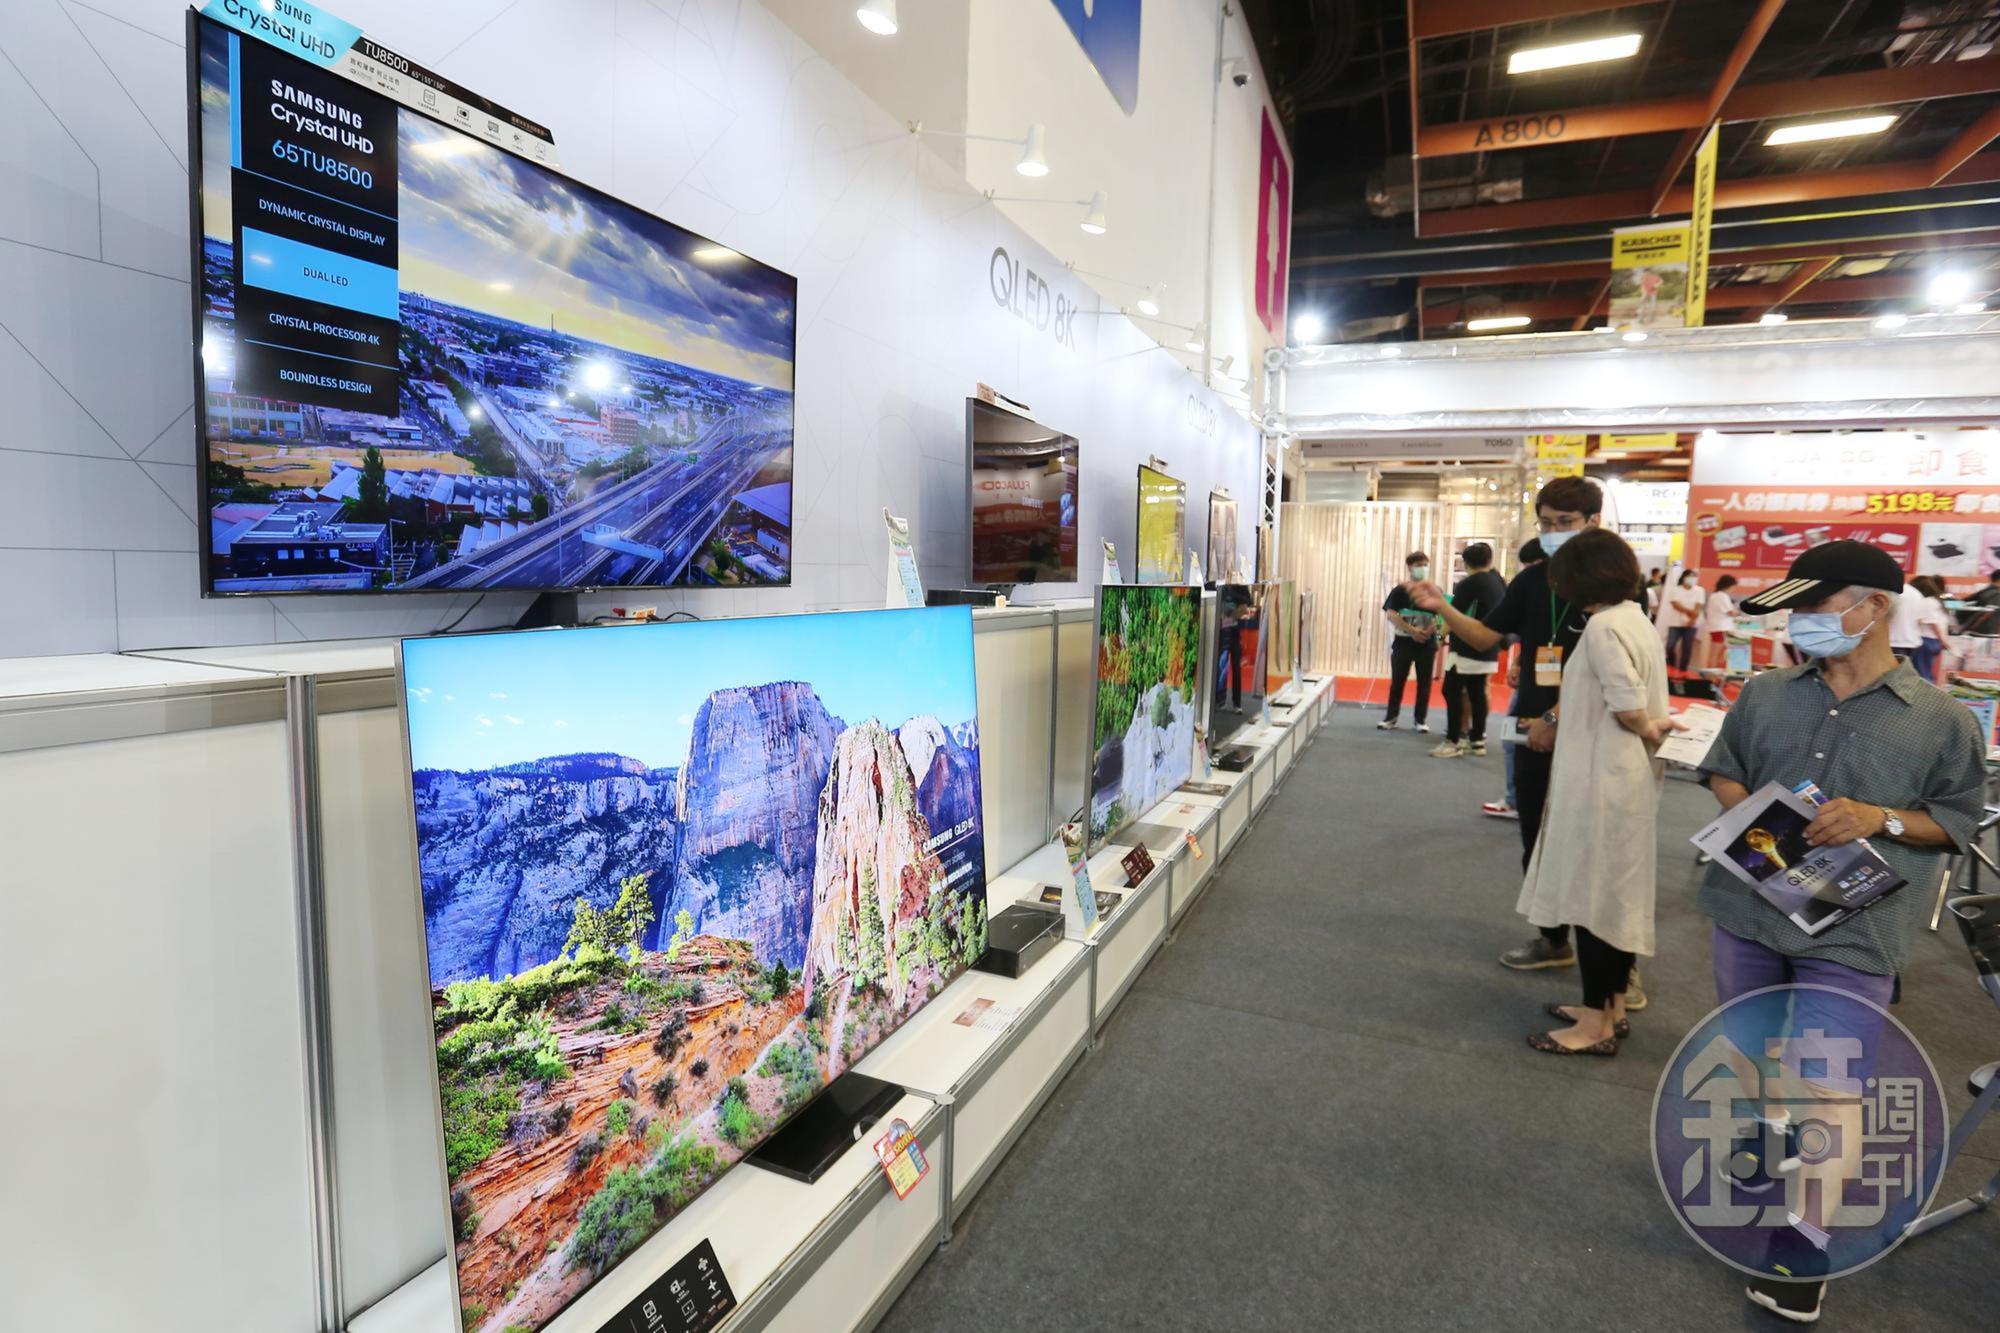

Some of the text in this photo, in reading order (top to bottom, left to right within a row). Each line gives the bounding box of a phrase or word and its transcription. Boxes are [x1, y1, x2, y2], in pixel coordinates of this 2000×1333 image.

[223, 0, 336, 59] Crystal UHD
[363, 41, 409, 73] TU8500
[271, 79, 363, 129] SAMSUNG
[270, 103, 374, 155] Crystal UHD
[1475, 113, 1566, 148] A 800
[272, 138, 373, 190] 65TU8500
[259, 198, 386, 247] DYNAMIC CRYSTAL DISPLAY
[303, 266, 349, 287] DUAL LED
[990, 246, 1078, 352] QLED 8K
[269, 313, 380, 346] CRYSTAL PROCESSOR 4K
[280, 370, 372, 394] BOUNDLESS DESIGN
[1787, 864, 1817, 887] QLED
[1814, 855, 1833, 869] 8K
